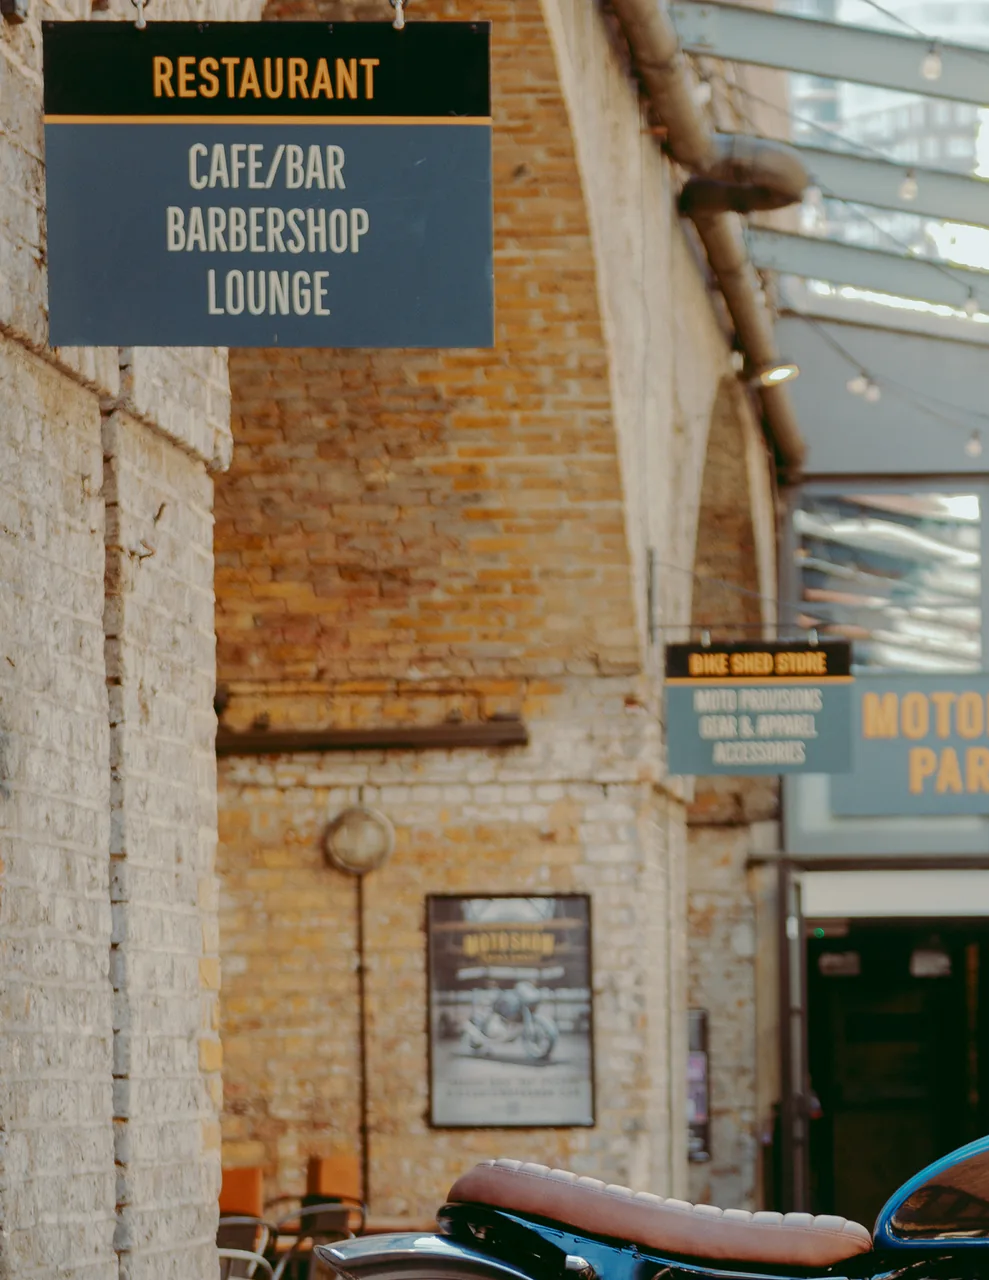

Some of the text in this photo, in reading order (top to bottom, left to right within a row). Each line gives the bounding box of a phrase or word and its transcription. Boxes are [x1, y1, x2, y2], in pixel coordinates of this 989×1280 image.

[153, 56, 380, 99] RESTAURANT
[188, 143, 346, 190] CAFE/BAR
[166, 206, 370, 253] BARBERSHOP
[208, 269, 331, 316] LOUNGE
[689, 651, 827, 676] BIKE SHED STORE
[694, 688, 823, 712] MOTO PROVISIONS
[700, 714, 818, 738] GEAR & APPAREL
[713, 740, 806, 764] ACCESSORIES
